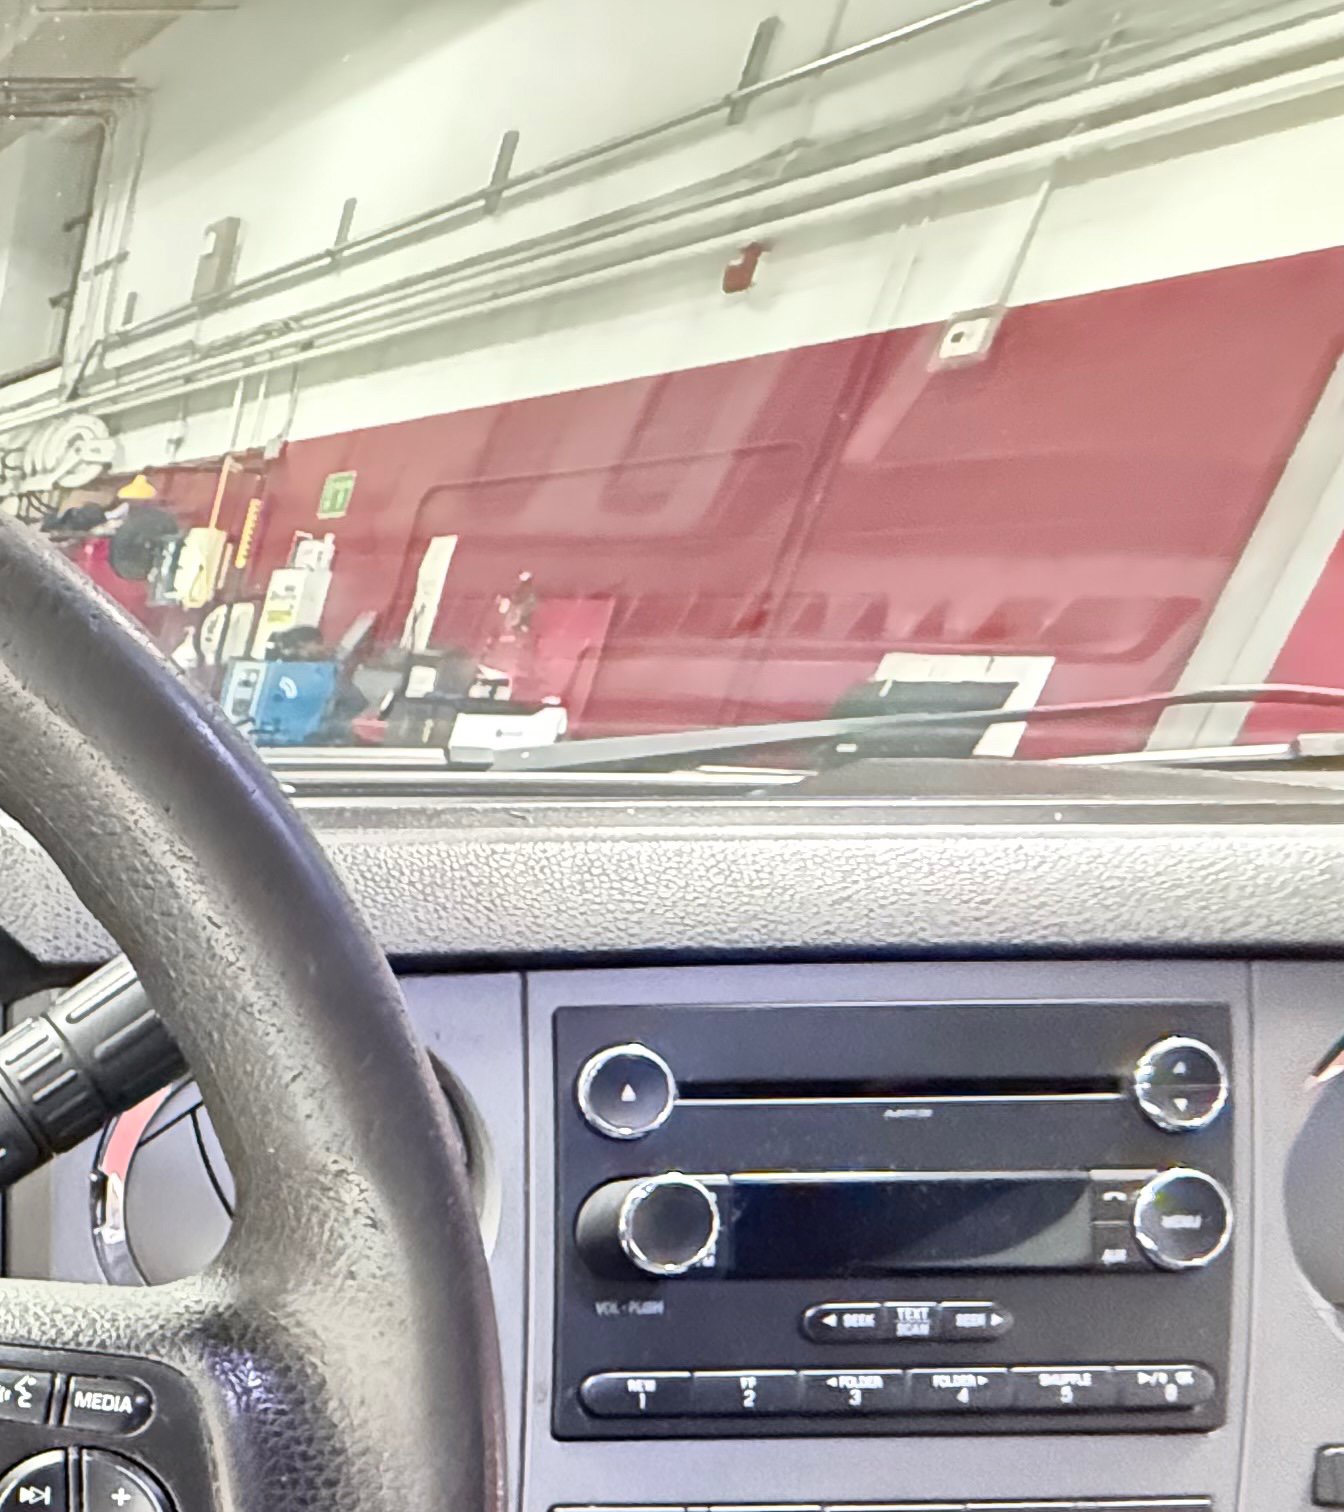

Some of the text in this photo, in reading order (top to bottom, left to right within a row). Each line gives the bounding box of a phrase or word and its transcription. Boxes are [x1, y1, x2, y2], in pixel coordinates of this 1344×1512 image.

[896, 1306, 930, 1321] TEXT
[74, 1391, 133, 1414] MEDIA
[638, 1393, 647, 1410] 1
[742, 1390, 757, 1408] 2
[848, 1389, 862, 1406] 3
[956, 1388, 970, 1404] 4
